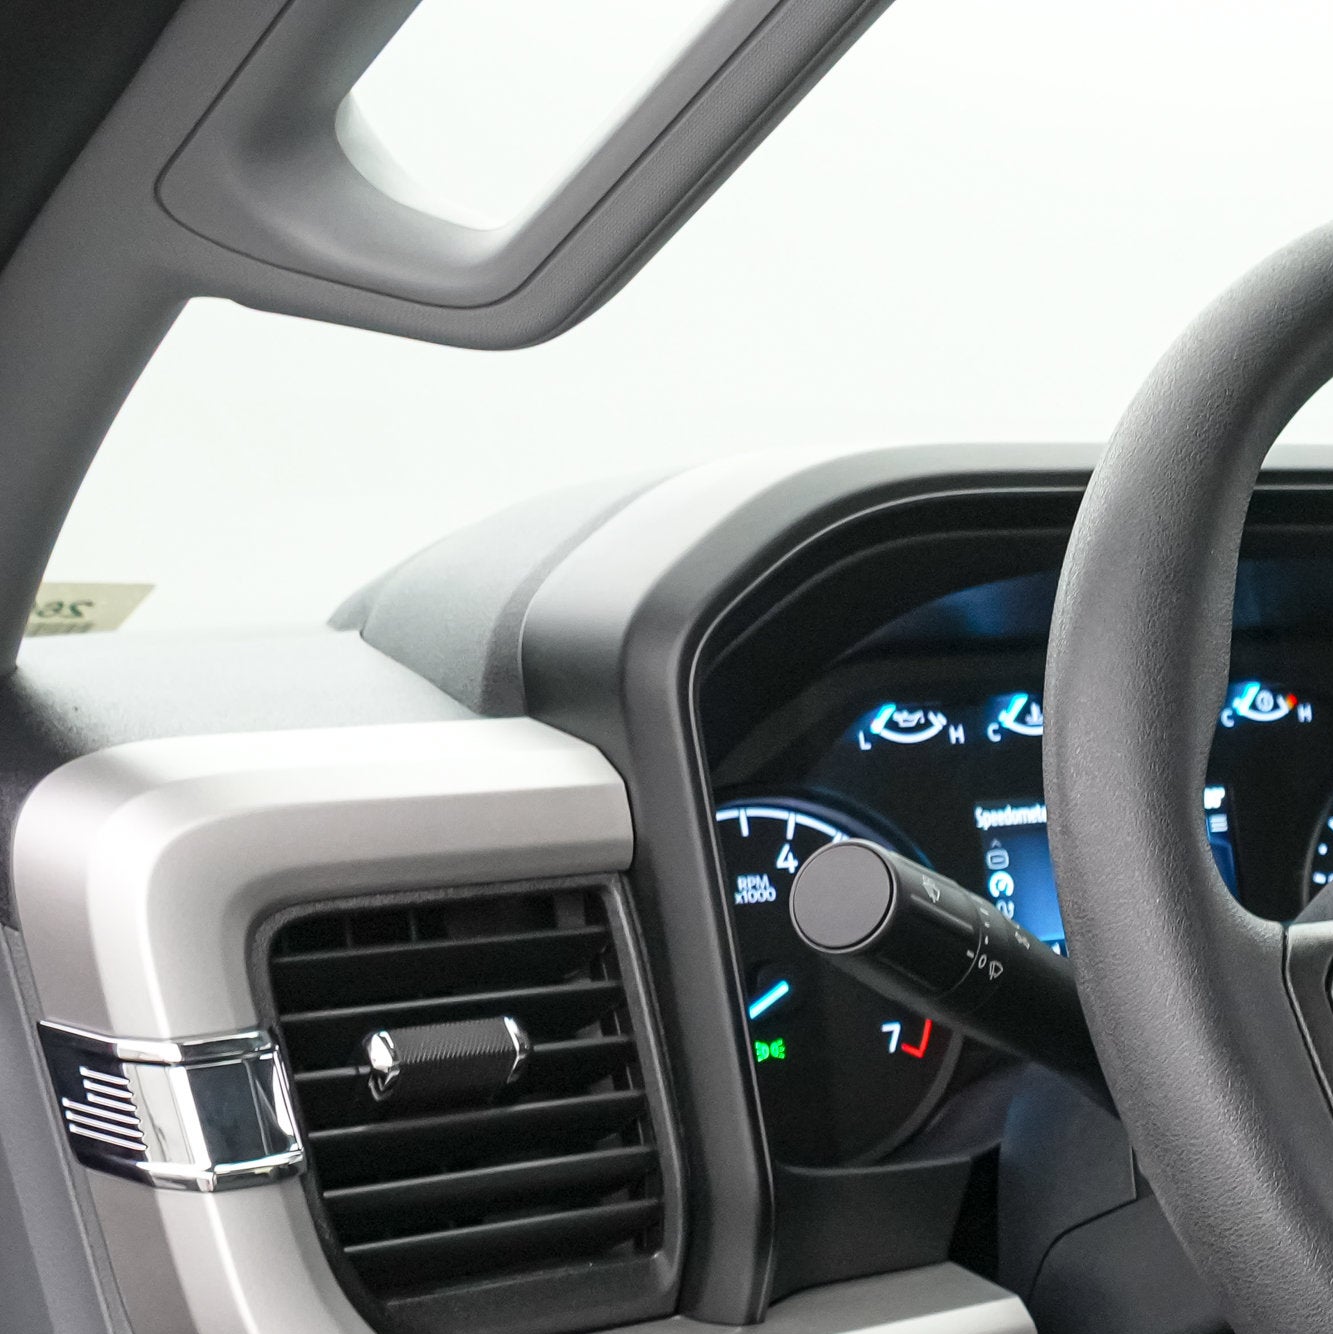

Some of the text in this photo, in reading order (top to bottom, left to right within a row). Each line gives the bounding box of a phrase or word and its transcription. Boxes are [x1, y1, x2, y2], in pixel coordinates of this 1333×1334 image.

[1220, 708, 1235, 728] C
[1297, 702, 1313, 723] H
[857, 730, 872, 751] L
[949, 723, 965, 744] H
[986, 722, 1002, 742] C
[775, 843, 799, 874] 4
[737, 873, 770, 891] RPM
[881, 1021, 901, 1054] 7
